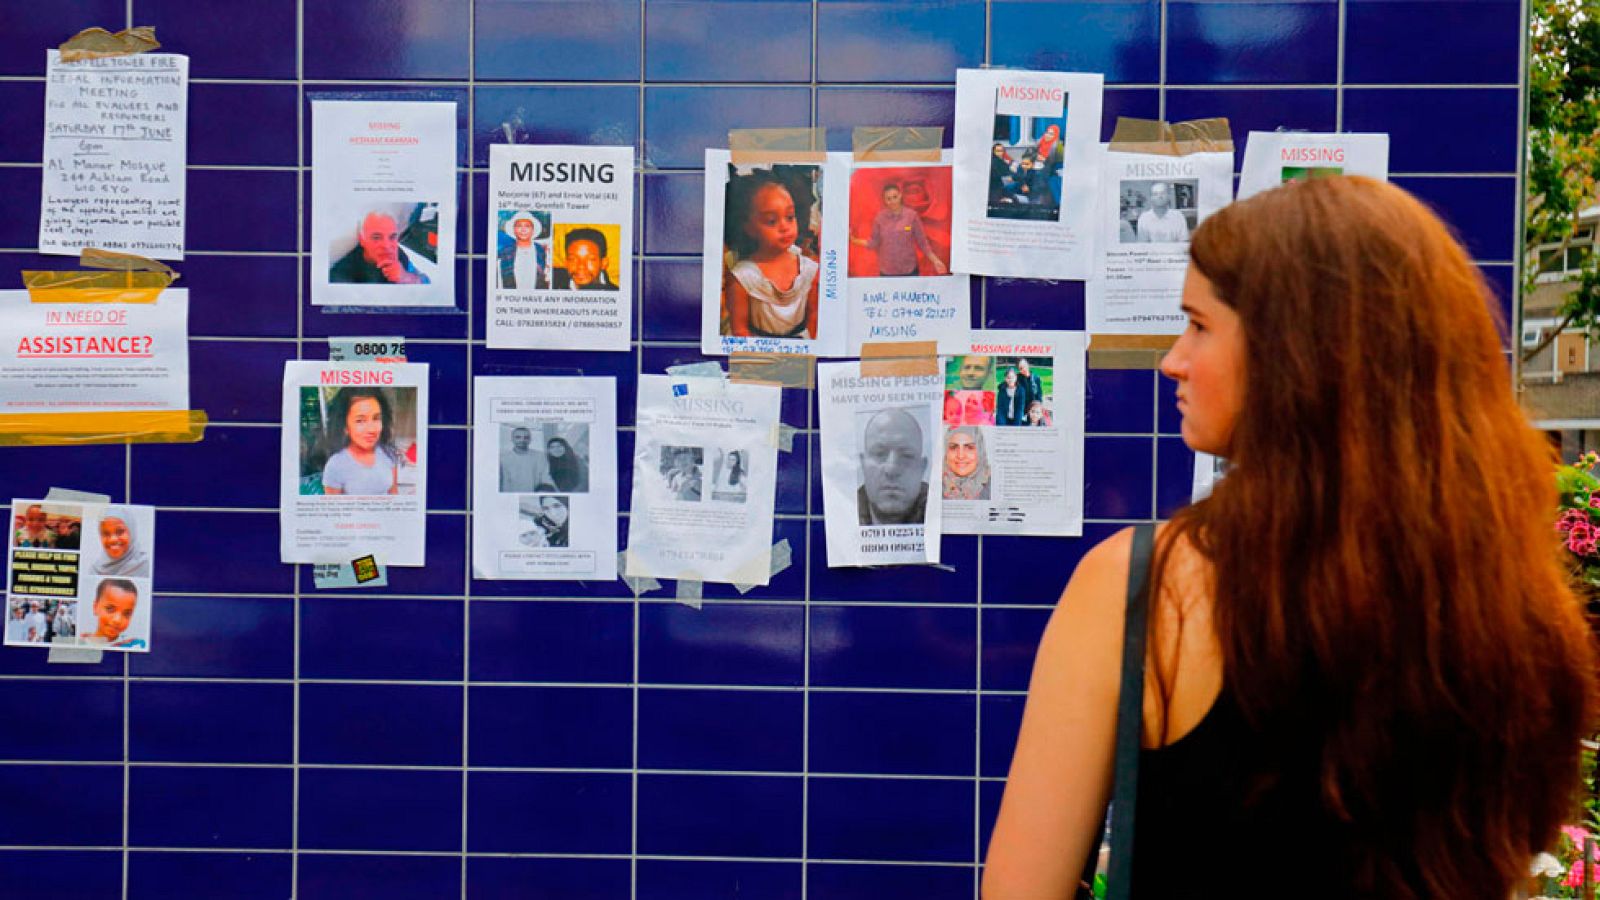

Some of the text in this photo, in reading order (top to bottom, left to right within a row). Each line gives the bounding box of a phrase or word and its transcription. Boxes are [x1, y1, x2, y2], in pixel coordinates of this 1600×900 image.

[151, 57, 176, 67] FIRE
[51, 74, 181, 86] LEAL INFORMATION
[79, 86, 140, 98] MEETING
[1000, 85, 1062, 101] MISSING
[156, 102, 179, 111] AND
[48, 122, 105, 135] SATURDAY
[141, 127, 173, 138] JUNE
[1281, 147, 1344, 162] MISSING
[121, 160, 166, 173] Mosque
[510, 162, 615, 183] MISSING
[1126, 162, 1193, 177] MISSING
[94, 197, 152, 209] representing
[826, 250, 837, 299] MISSING
[863, 291, 888, 303] AMAL
[46, 310, 128, 323] IN NEED OF
[510, 307, 531, 315] THEIR
[533, 308, 590, 316] WHEREABOUTS
[869, 323, 917, 338] MISSING
[17, 336, 153, 354] ASSISTANCE?
[355, 343, 387, 355] 0800
[971, 344, 1051, 353] MISSING FAMILY
[321, 370, 393, 384] MISSING
[831, 377, 890, 389] MISSING
[832, 394, 860, 404] HAVE
[863, 393, 885, 403] YOU
[888, 392, 915, 402] SEEN
[672, 398, 744, 414] MISSING
